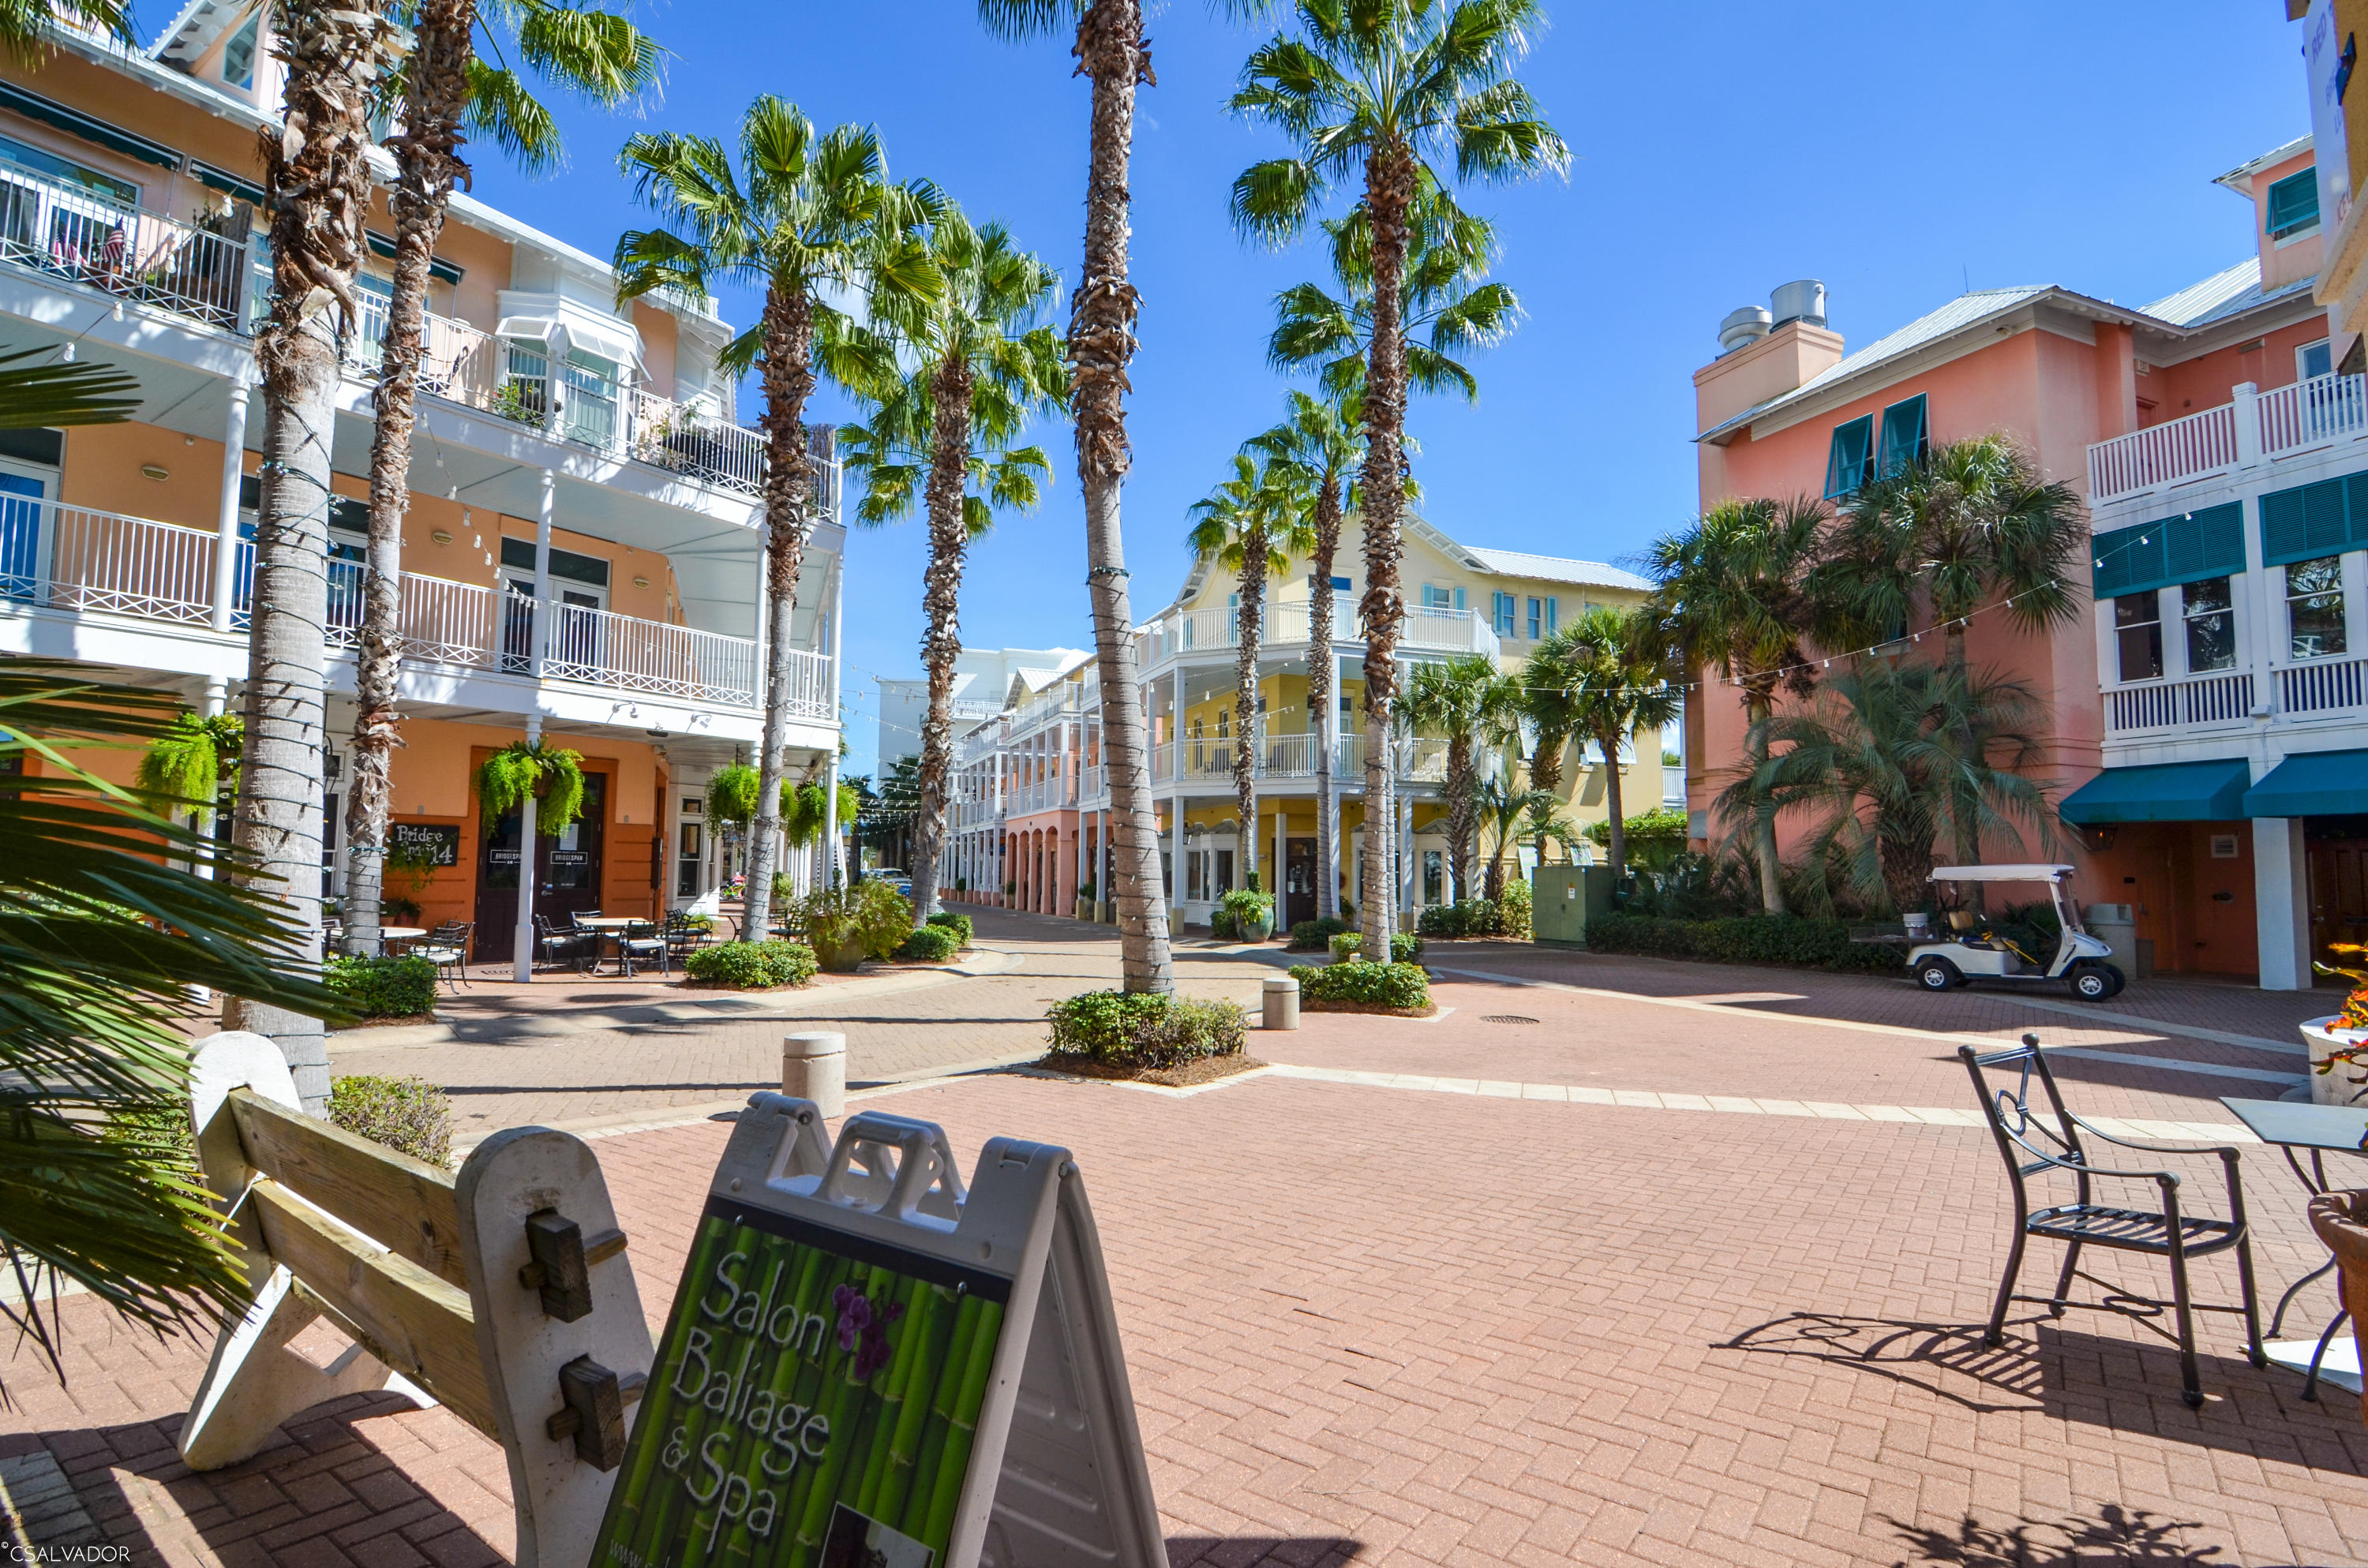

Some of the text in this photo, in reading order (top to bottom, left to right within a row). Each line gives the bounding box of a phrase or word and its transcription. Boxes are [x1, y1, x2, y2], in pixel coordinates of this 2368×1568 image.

[396, 825, 443, 846] Bridge
[430, 844, 453, 864] 14
[701, 1252, 826, 1356] Salon
[670, 1327, 830, 1476] Baliage
[662, 1425, 777, 1554] & Spa
